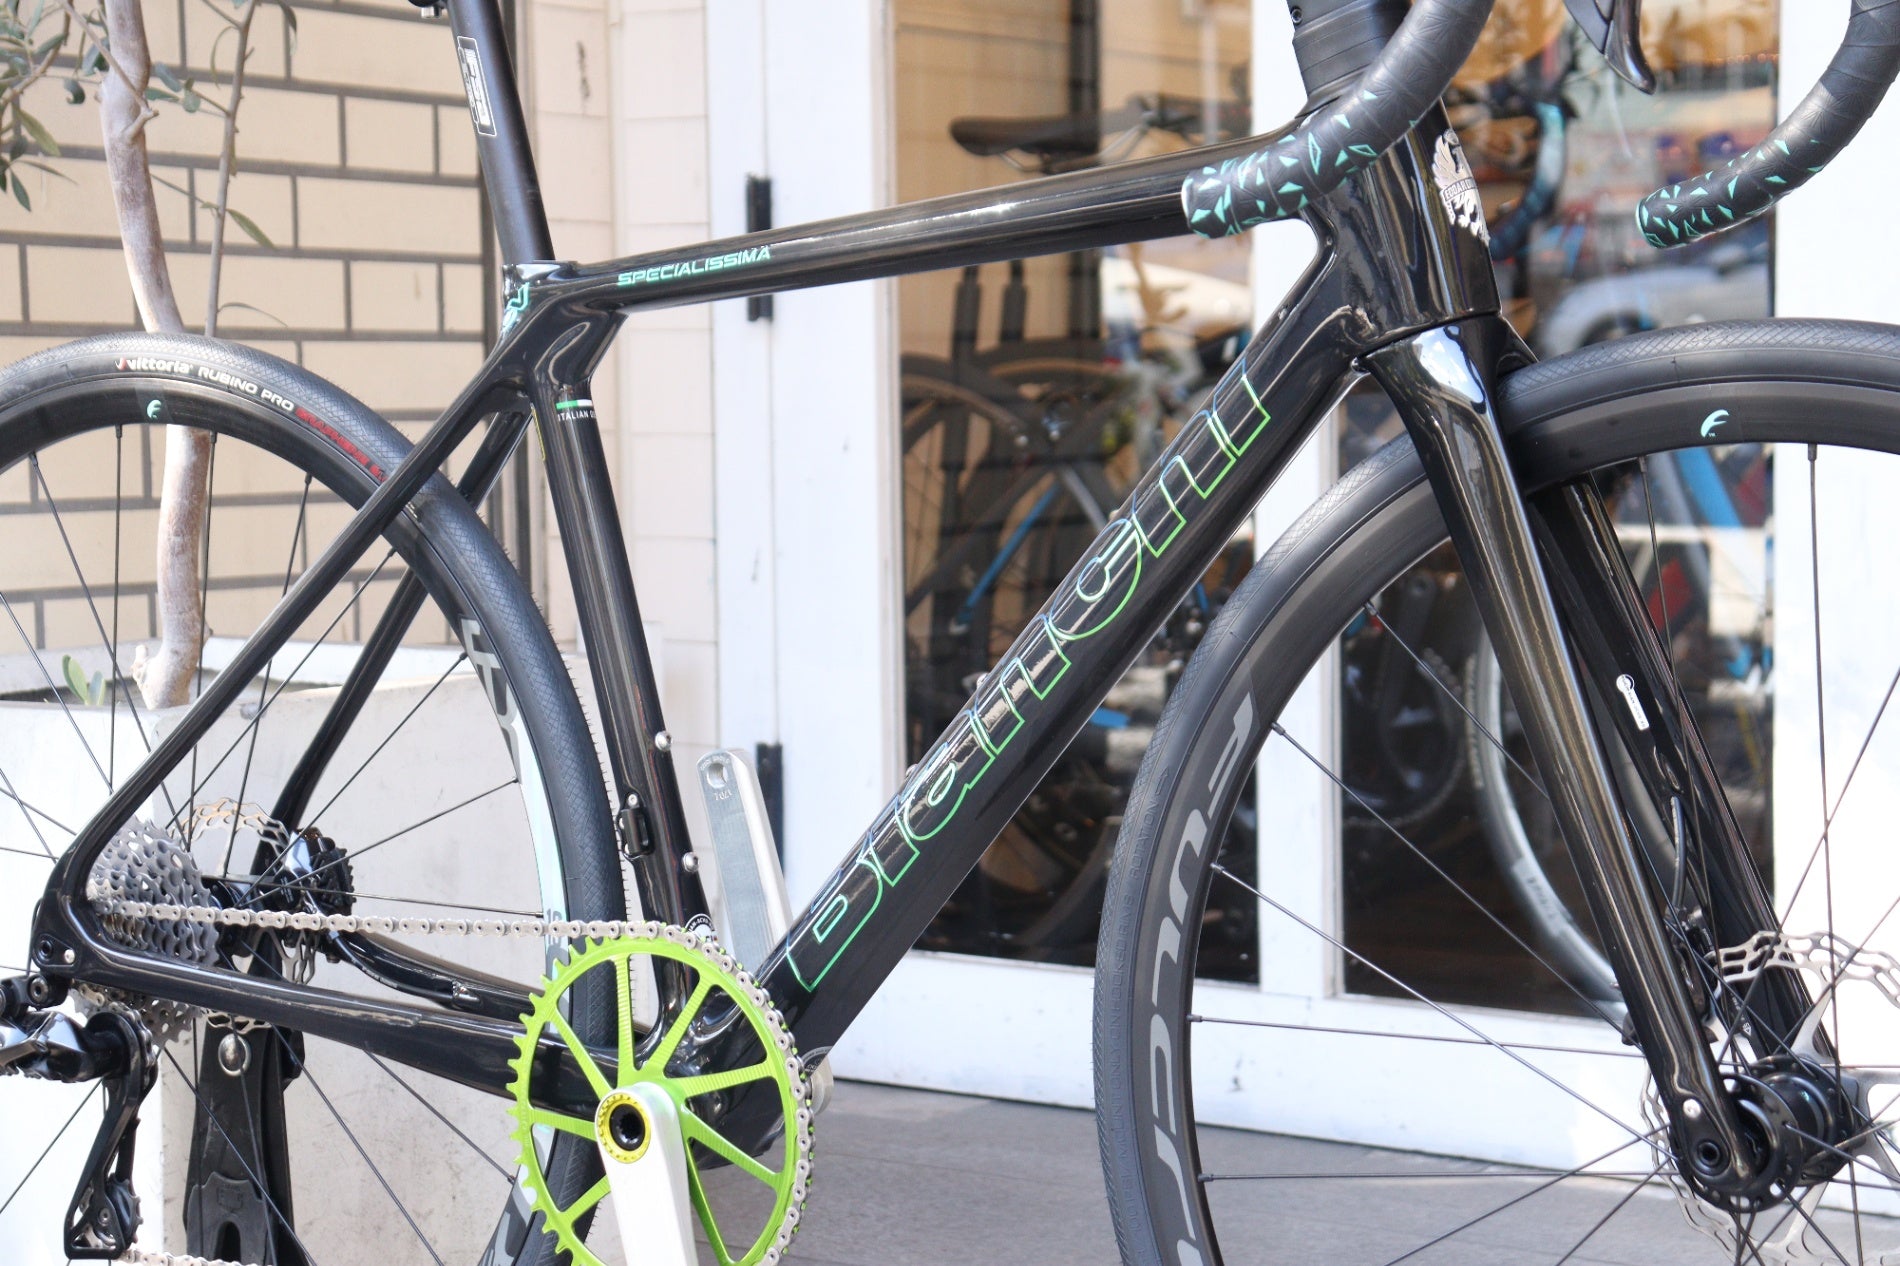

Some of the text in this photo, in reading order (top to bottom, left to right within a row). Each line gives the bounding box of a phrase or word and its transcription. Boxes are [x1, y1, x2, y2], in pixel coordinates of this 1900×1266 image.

[617, 245, 771, 286] SPECIALISSIMA
[125, 357, 190, 374] vittoria
[198, 366, 258, 394] RUBINO
[260, 388, 295, 412] PRO
[557, 409, 589, 422] ITALIAN
[1150, 691, 1253, 1266] FULCR
